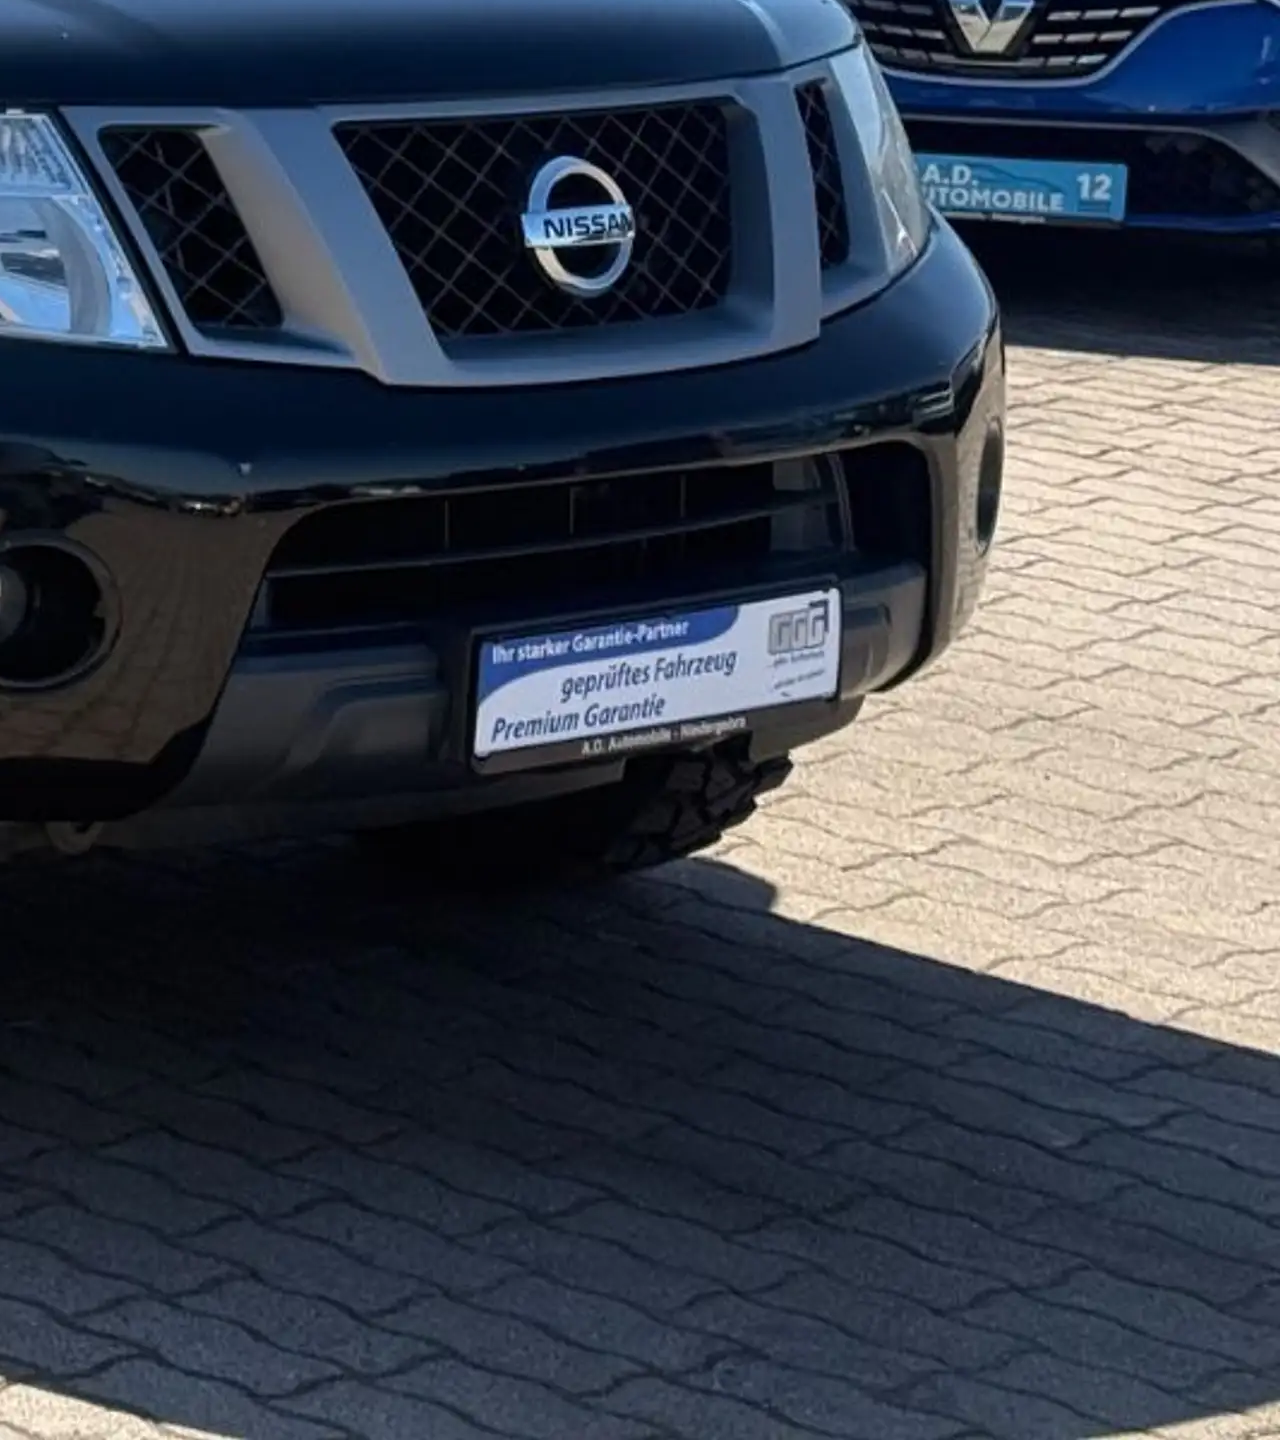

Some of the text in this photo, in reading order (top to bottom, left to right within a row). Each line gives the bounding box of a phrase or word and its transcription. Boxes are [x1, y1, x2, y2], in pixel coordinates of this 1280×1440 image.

[920, 163, 980, 187] A.D.
[1076, 173, 1112, 201] 12
[543, 211, 633, 239] NISSAN
[492, 621, 689, 665] Ihr starker Garantie-Partner
[560, 661, 651, 703] geprüftes
[653, 650, 738, 681] Fahrzeug
[491, 693, 666, 742] Premium Garantie
